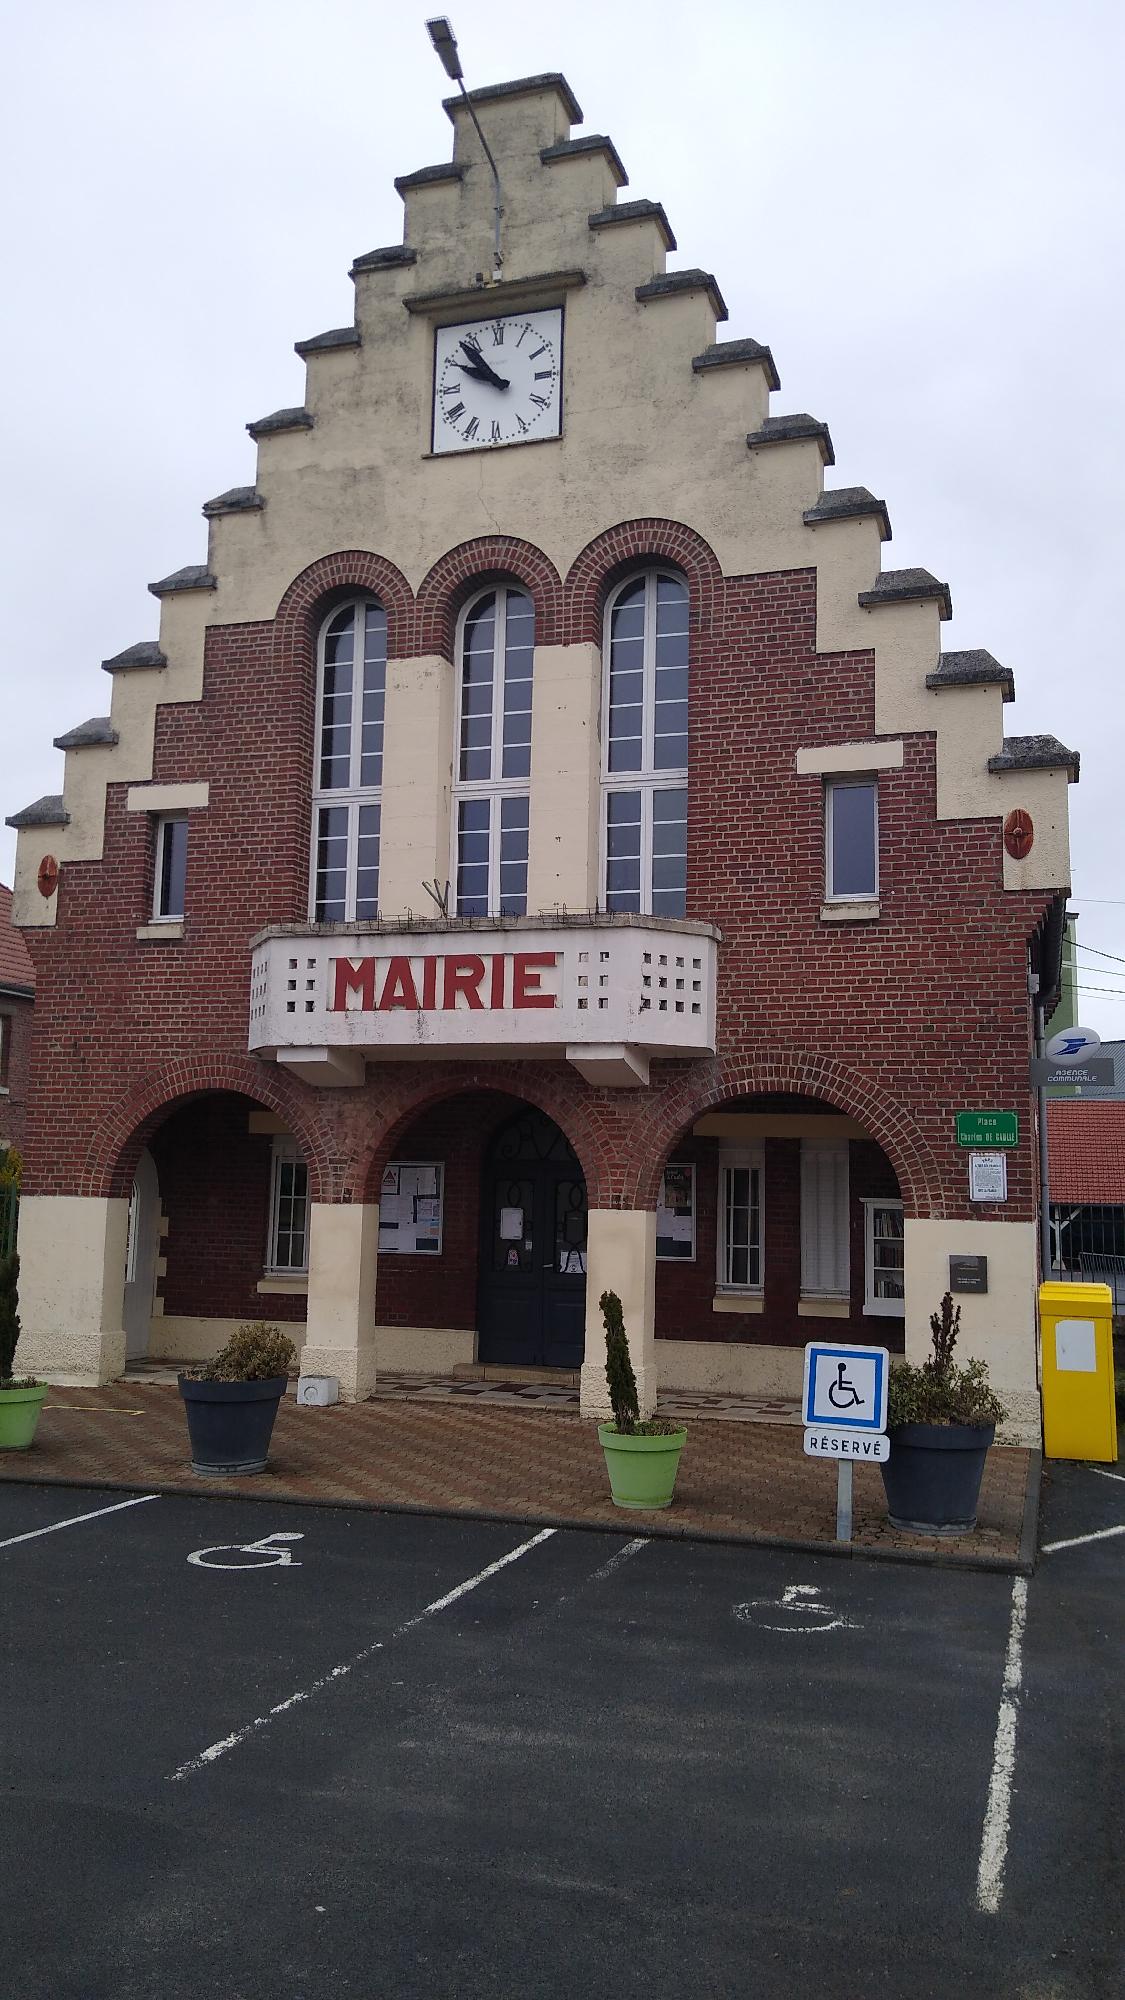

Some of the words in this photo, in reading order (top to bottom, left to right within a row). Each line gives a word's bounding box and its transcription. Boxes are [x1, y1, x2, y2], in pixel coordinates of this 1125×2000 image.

[334, 952, 557, 1011] MAIRIE
[977, 1117, 998, 1126] Place
[985, 1132, 993, 1142] DE
[995, 1132, 1015, 1142] GAULLE
[810, 1436, 881, 1455] RÉSERVÉ
